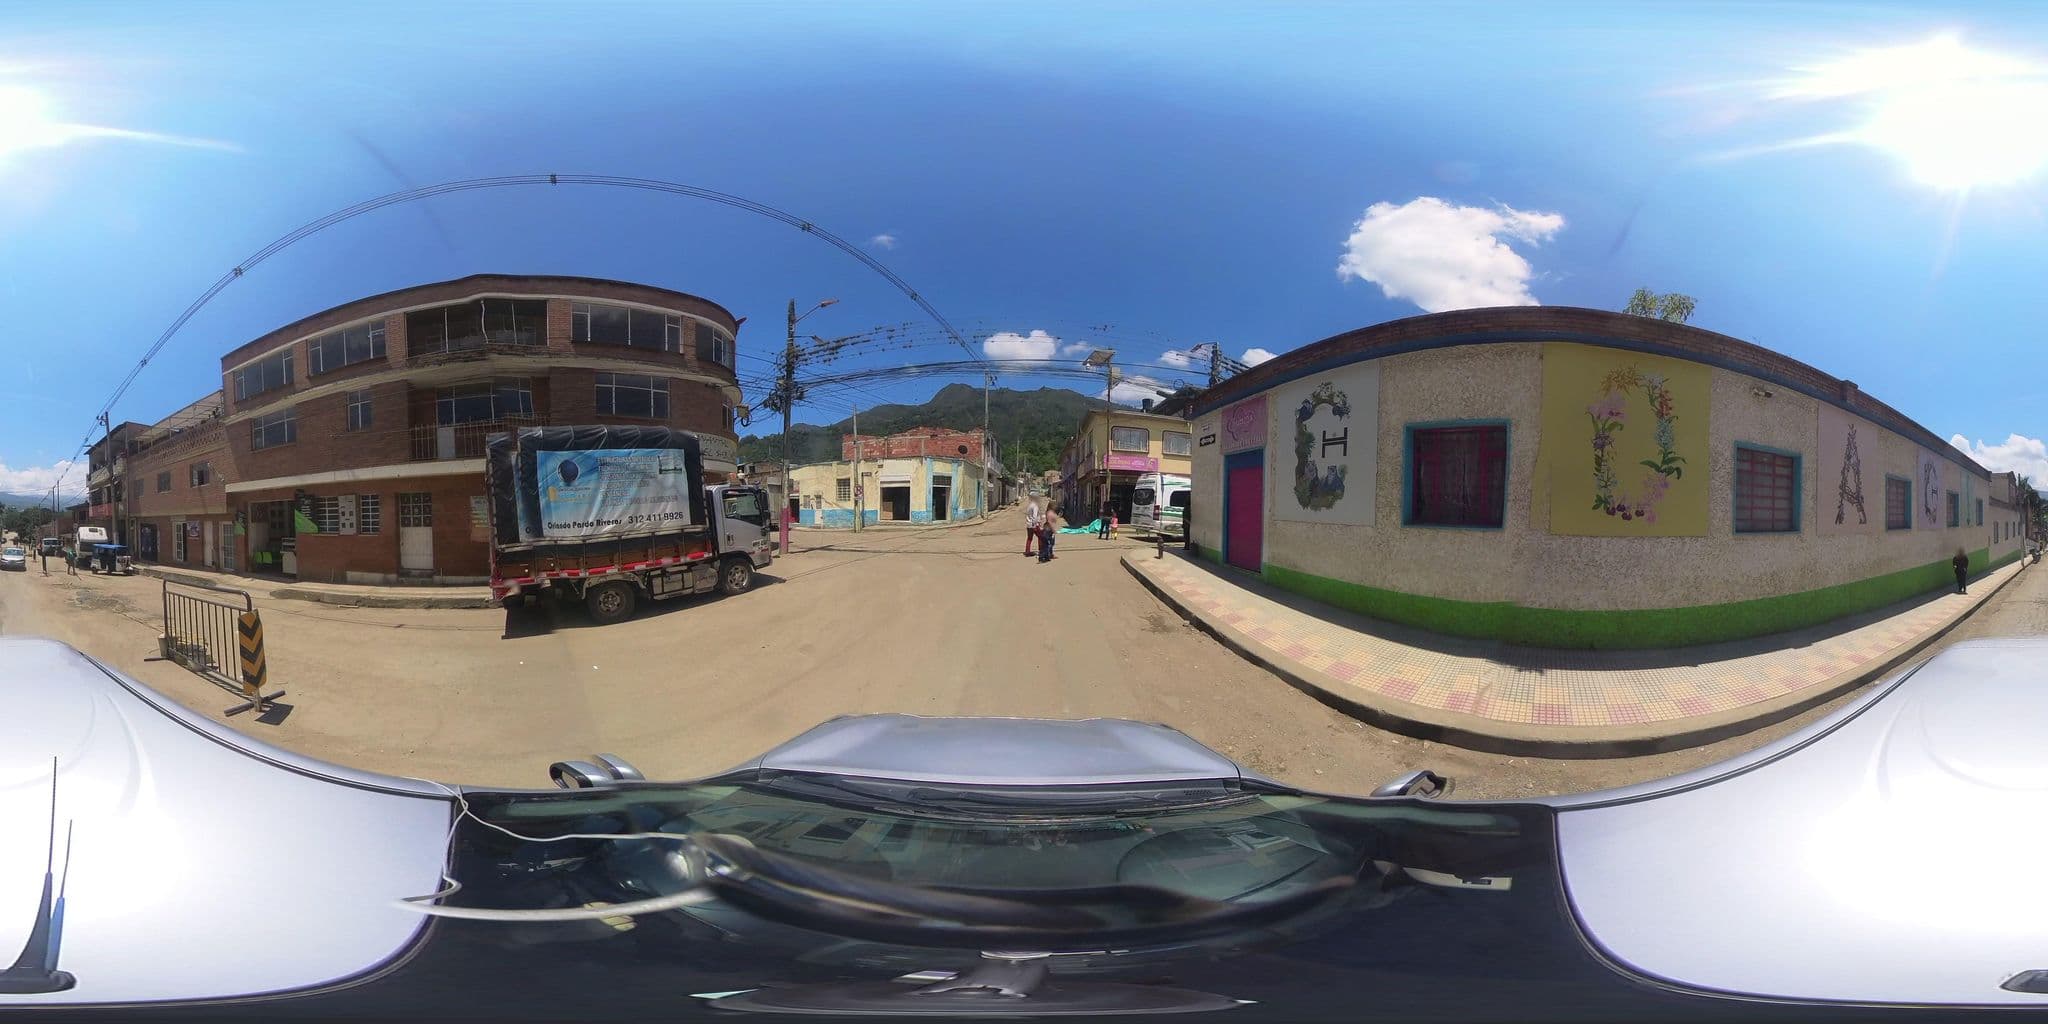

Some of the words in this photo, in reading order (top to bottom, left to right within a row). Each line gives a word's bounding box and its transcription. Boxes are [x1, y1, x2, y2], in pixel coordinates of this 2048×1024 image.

[572, 521, 594, 529] Pardo
[596, 518, 622, 527] Riveros
[628, 514, 644, 524] 312
